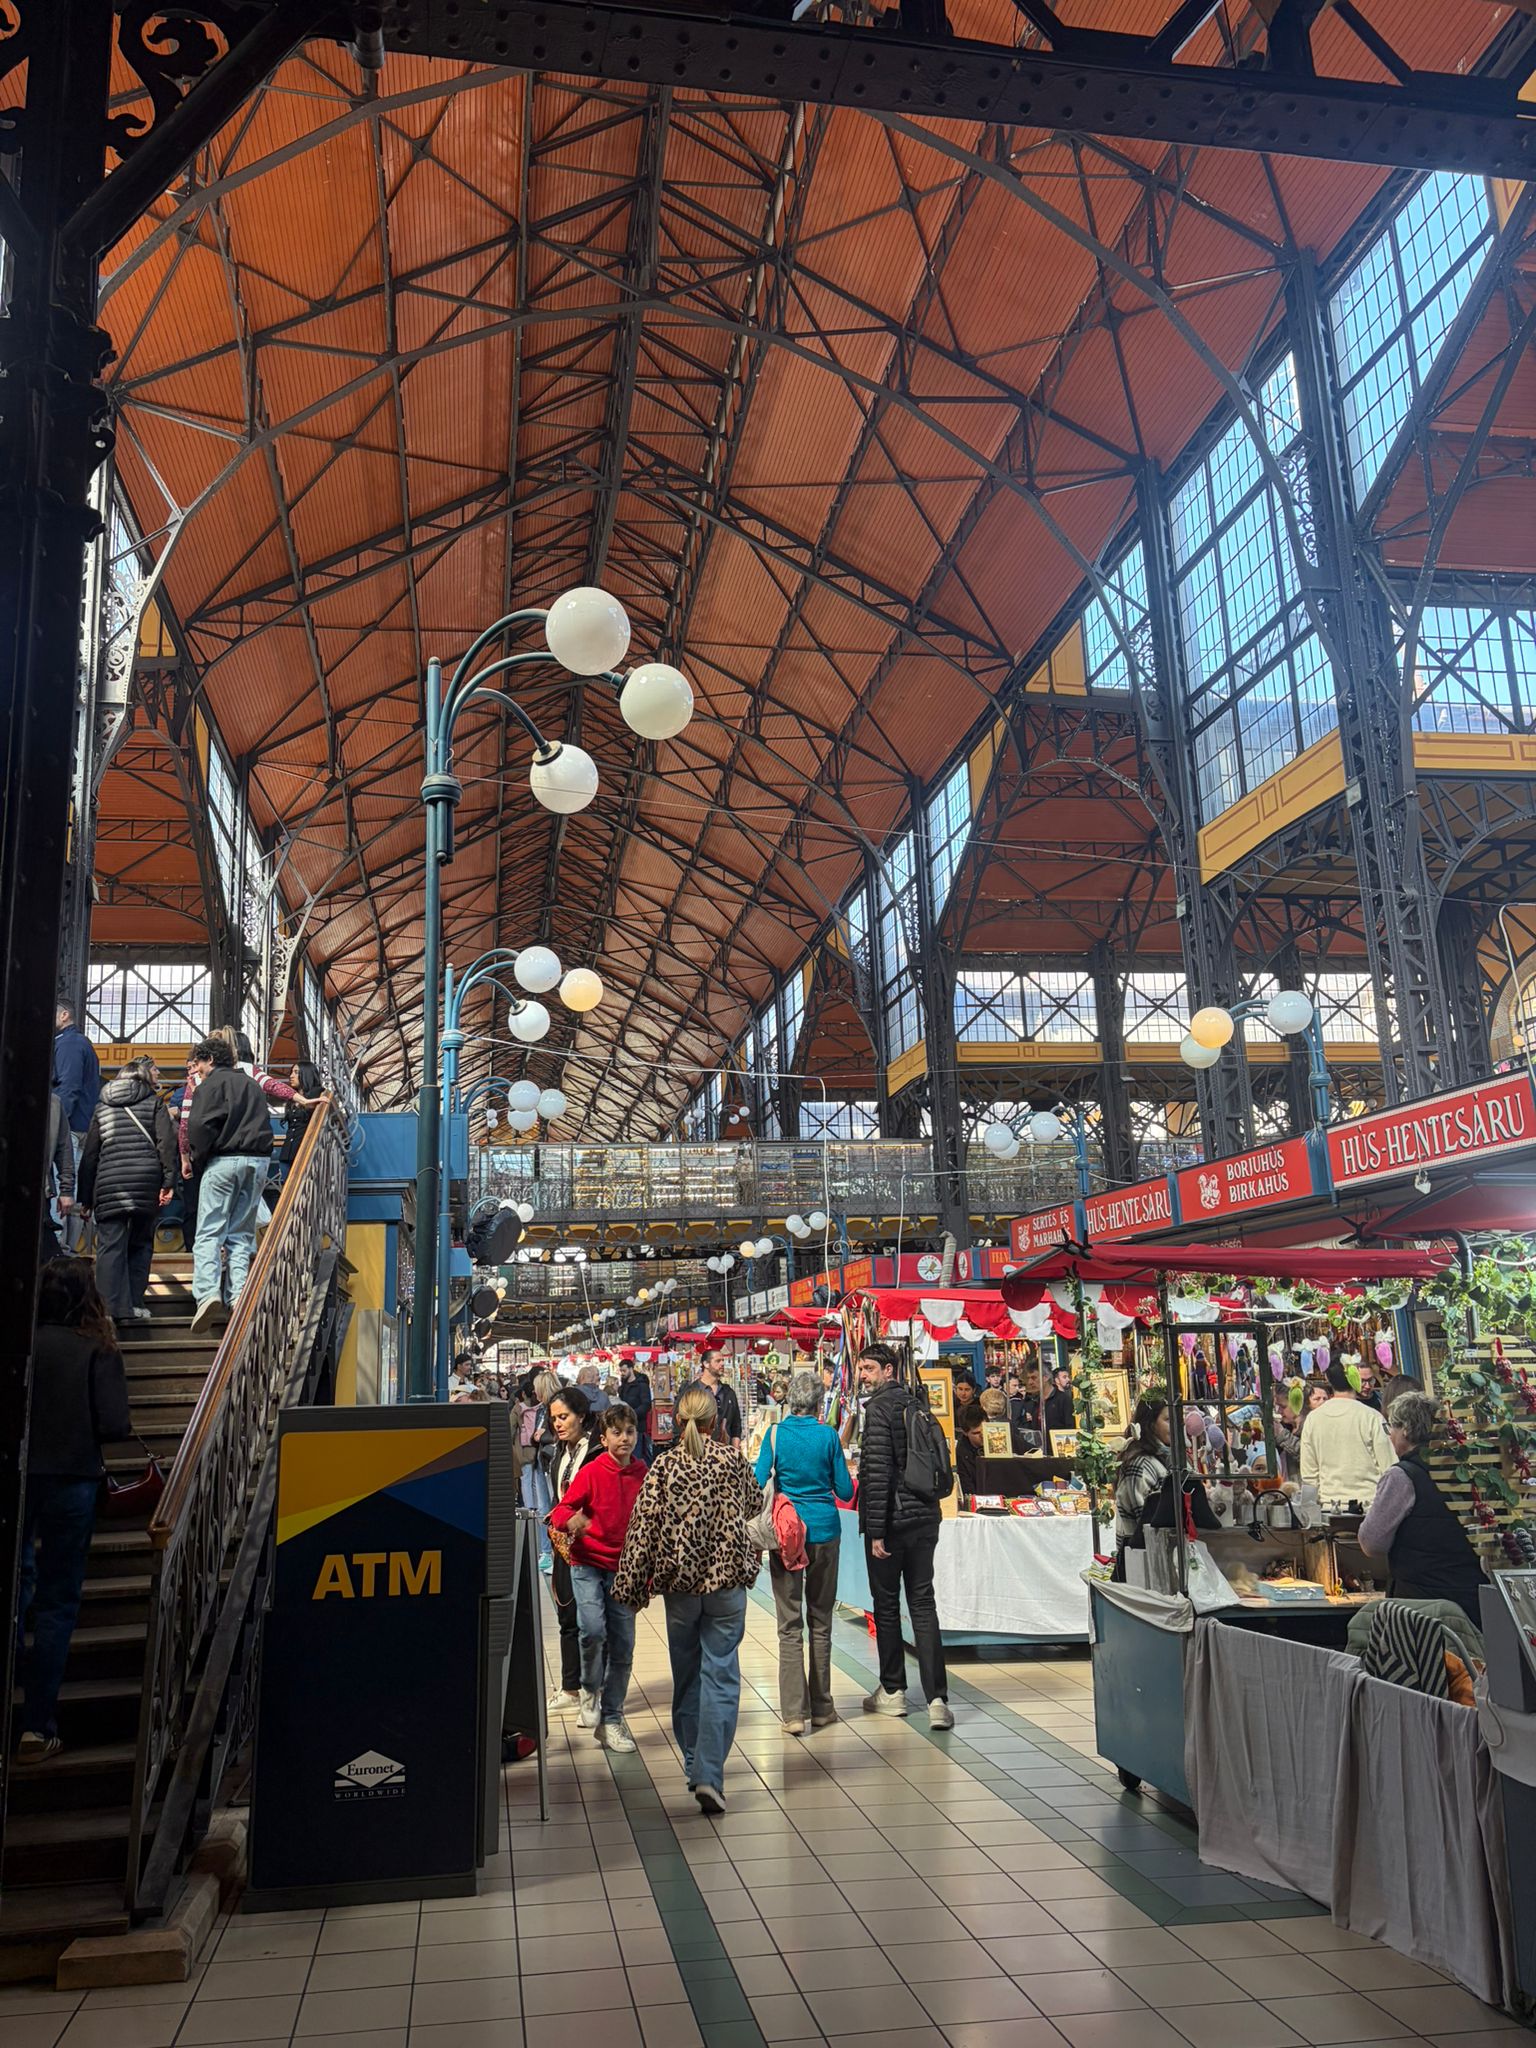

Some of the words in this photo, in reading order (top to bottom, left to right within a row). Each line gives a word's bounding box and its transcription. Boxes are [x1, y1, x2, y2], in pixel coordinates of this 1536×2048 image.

[1340, 1092, 1526, 1176] HÚS-HENTESÁRU
[1226, 1146, 1285, 1182] BORJUHÚS
[1229, 1169, 1289, 1203] BIRKAHÚS
[1032, 1211, 1057, 1231] SERTÉS
[1060, 1207, 1070, 1224] ÉS
[312, 1550, 442, 1600] ATM
[347, 1763, 394, 1777] Euronet
[335, 1788, 406, 1799] WORLDWIDE
